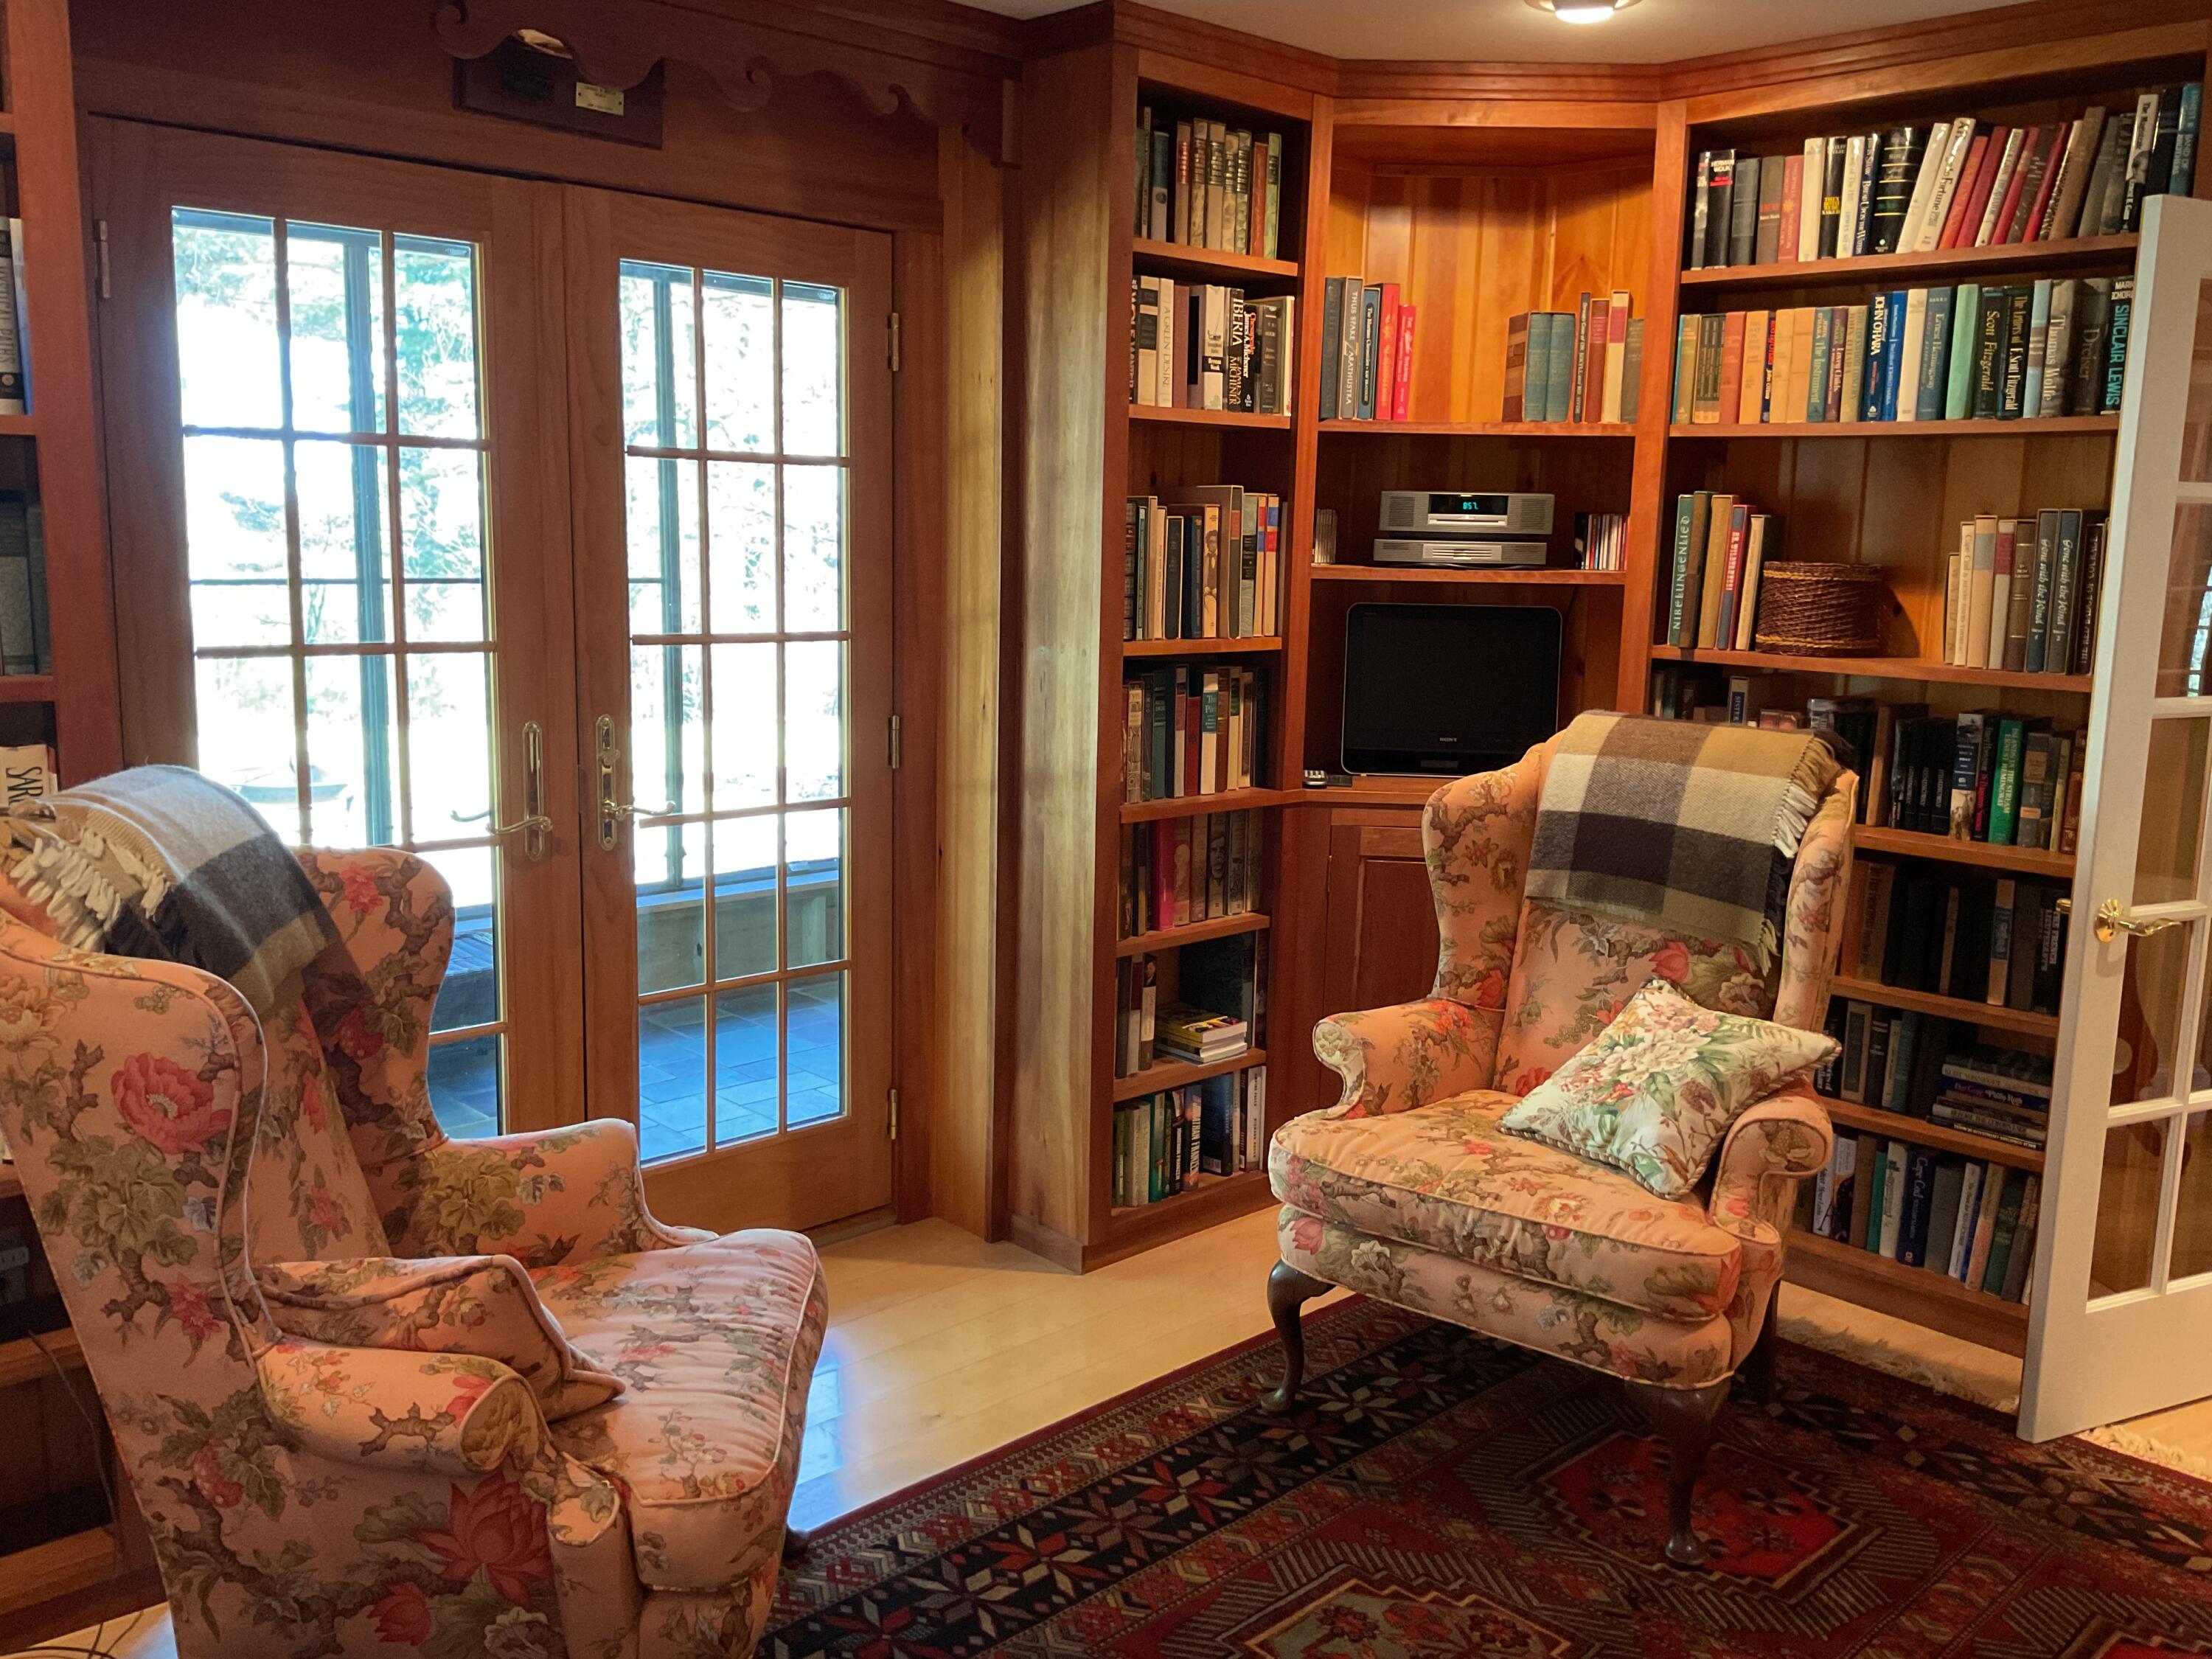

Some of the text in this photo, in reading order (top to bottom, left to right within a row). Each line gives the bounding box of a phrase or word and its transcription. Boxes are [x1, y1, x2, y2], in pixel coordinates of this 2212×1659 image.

[1933, 175, 1954, 211] Fortune
[1232, 298, 1245, 347] IBERIA
[1873, 296, 1885, 320] JOHN
[1933, 313, 1944, 339] Ernest
[1871, 321, 1883, 355] O'HARA
[1980, 310, 2000, 392] Scott Fitzgerald
[2043, 315, 2067, 401] Thomas Wolfe
[2079, 328, 2100, 380] Dreiser
[2106, 305, 2129, 406] SINCLAIR LEWIS
[1228, 355, 1237, 406] MICHENER
[1343, 341, 1358, 405] ZARATHUSTRA
[1811, 342, 1826, 403] The Instrument
[1926, 341, 1941, 390] Hemingway
[2008, 355, 2022, 374] Scott
[2005, 374, 2020, 411] Fitzgerald
[1672, 515, 1690, 630] NIBELUNGENLIED
[2035, 539, 2052, 625] Gone with the Wind
[2056, 539, 2073, 626] Gone with the Wind
[6, 766, 44, 805] SAR
[2003, 785, 2014, 814] STREAM
[1189, 1142, 1200, 1177] FRANZEN
[1912, 1158, 1928, 1180] Cape
[1913, 1181, 1926, 1199] Cod
